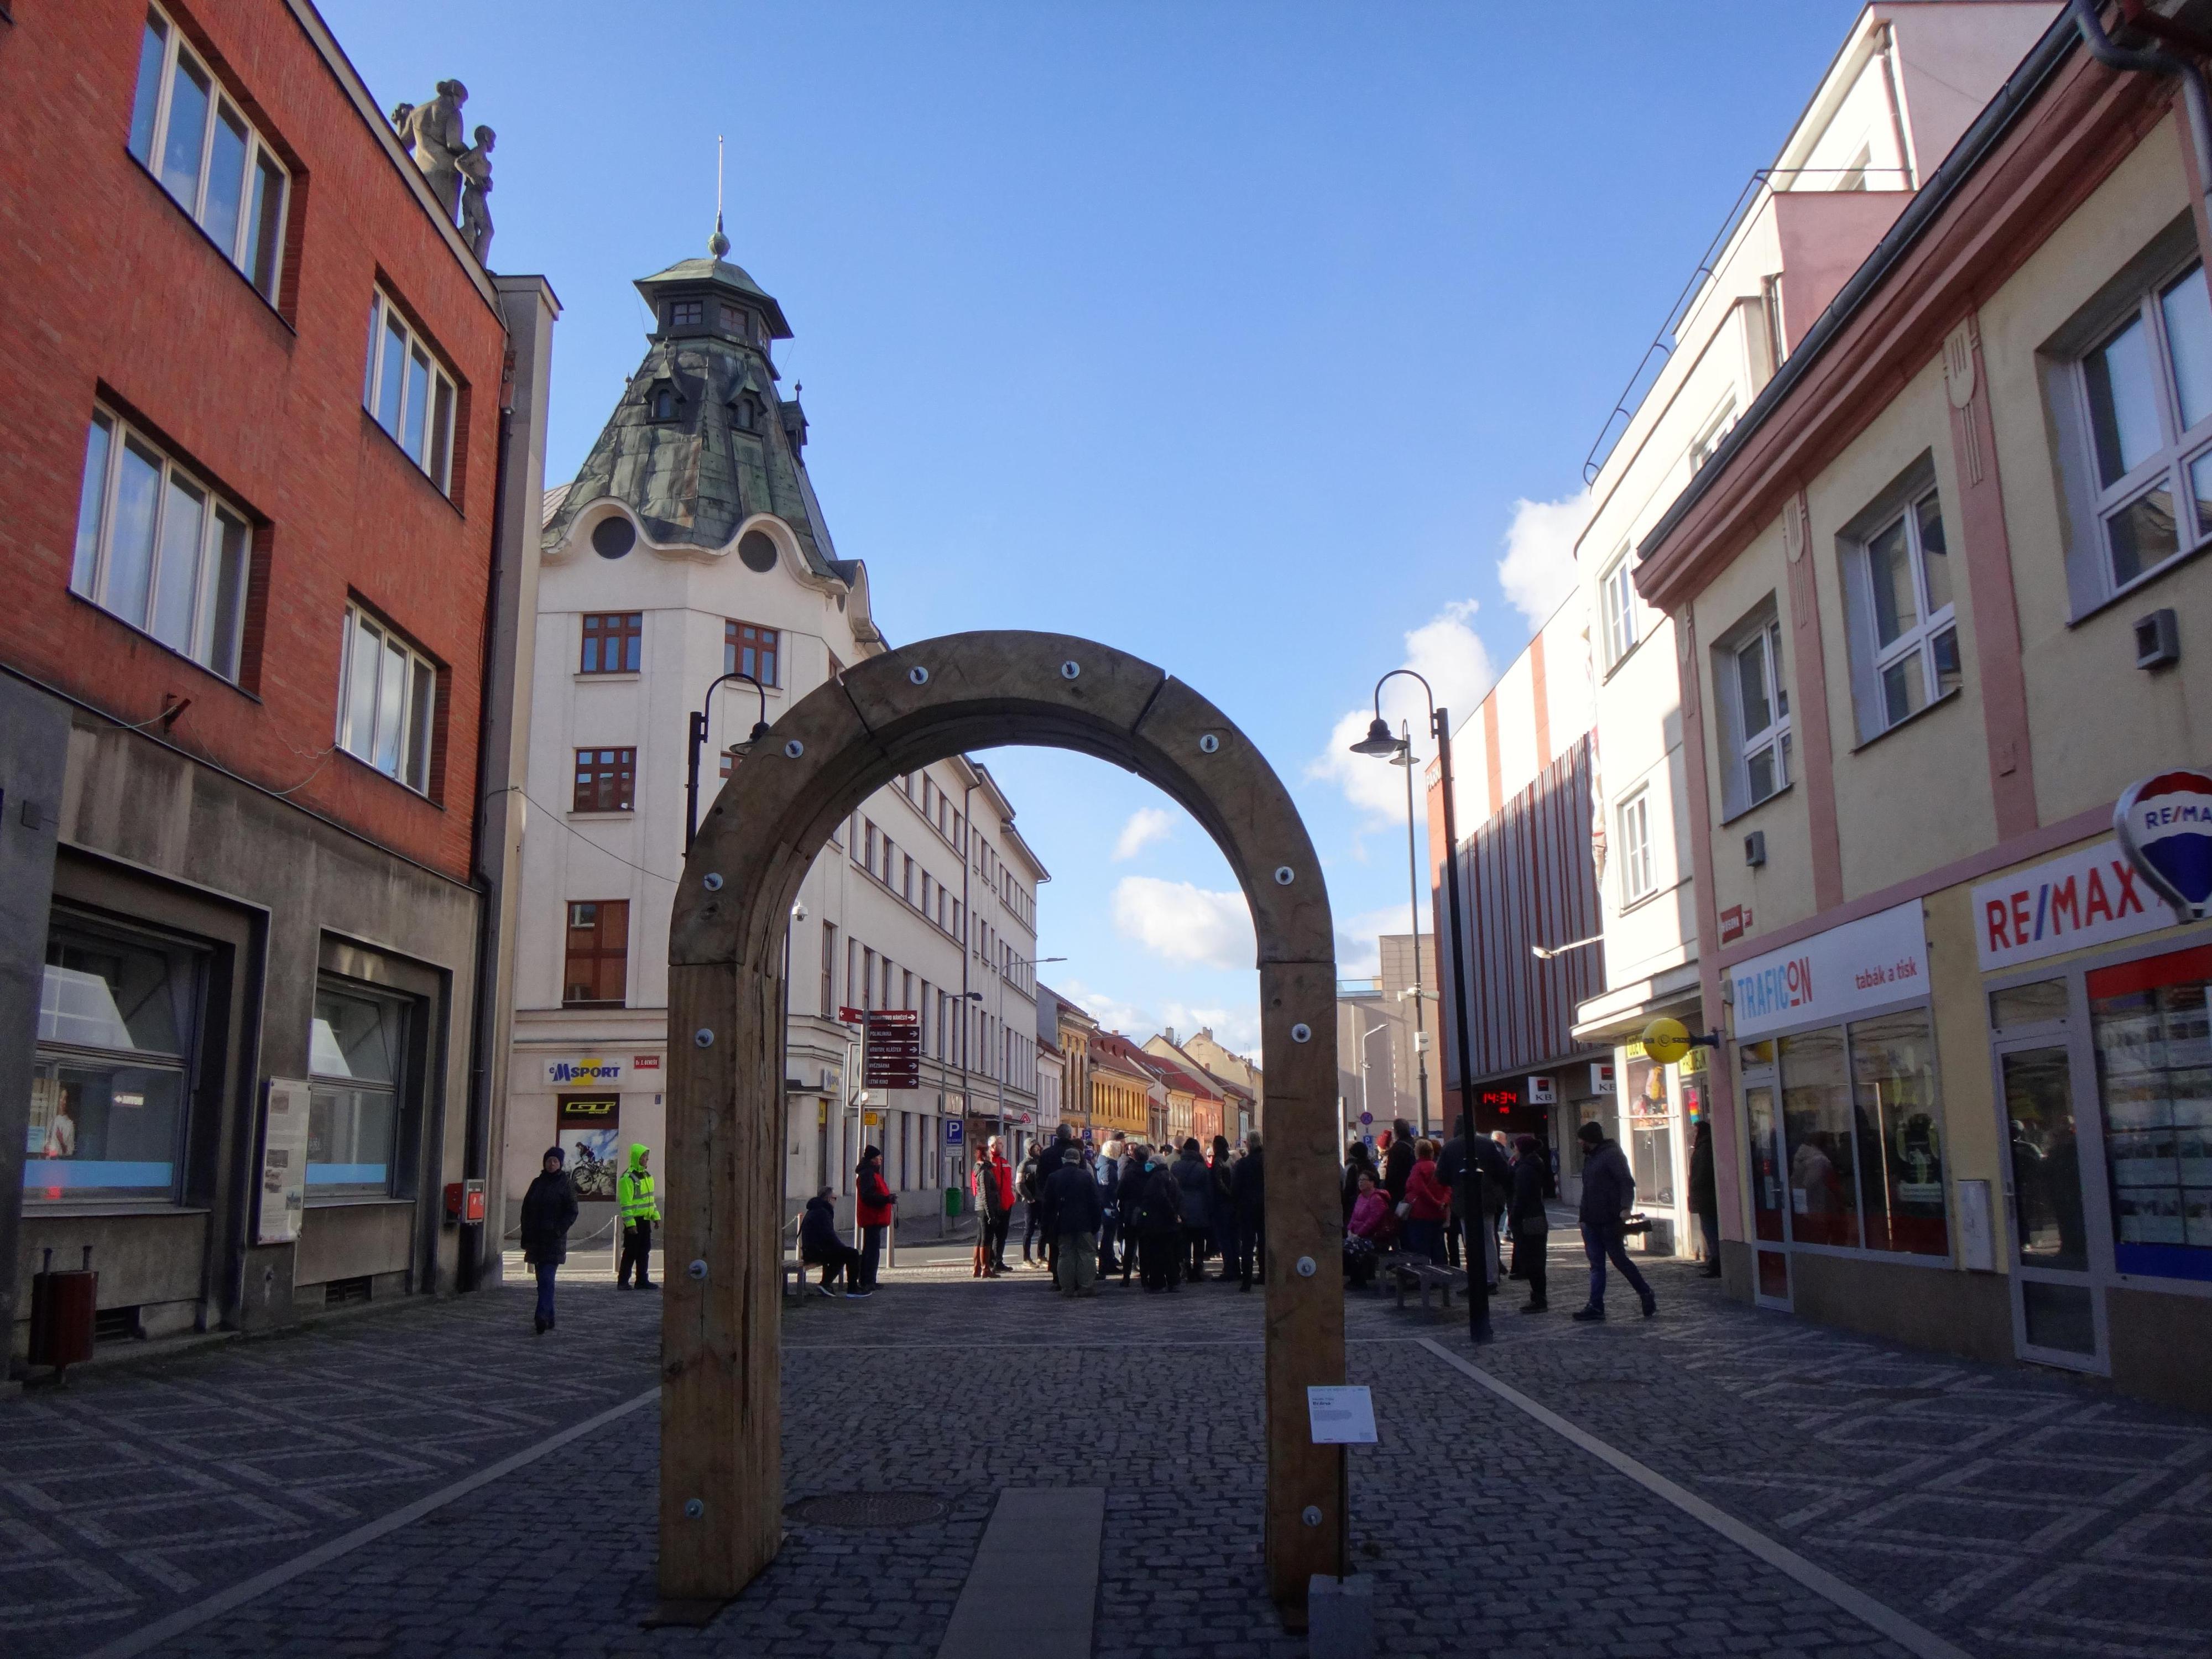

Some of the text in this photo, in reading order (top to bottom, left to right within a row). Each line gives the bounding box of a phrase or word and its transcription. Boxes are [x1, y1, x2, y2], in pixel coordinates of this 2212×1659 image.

[2145, 805, 2212, 830] RE/MA
[1986, 860, 2145, 952] RE/MAX
[1738, 956, 1813, 1020] TRAFICON
[1855, 957, 1918, 990] tabák a tisk
[1482, 1091, 1517, 1104] 14:34
[949, 1122, 960, 1138] P
